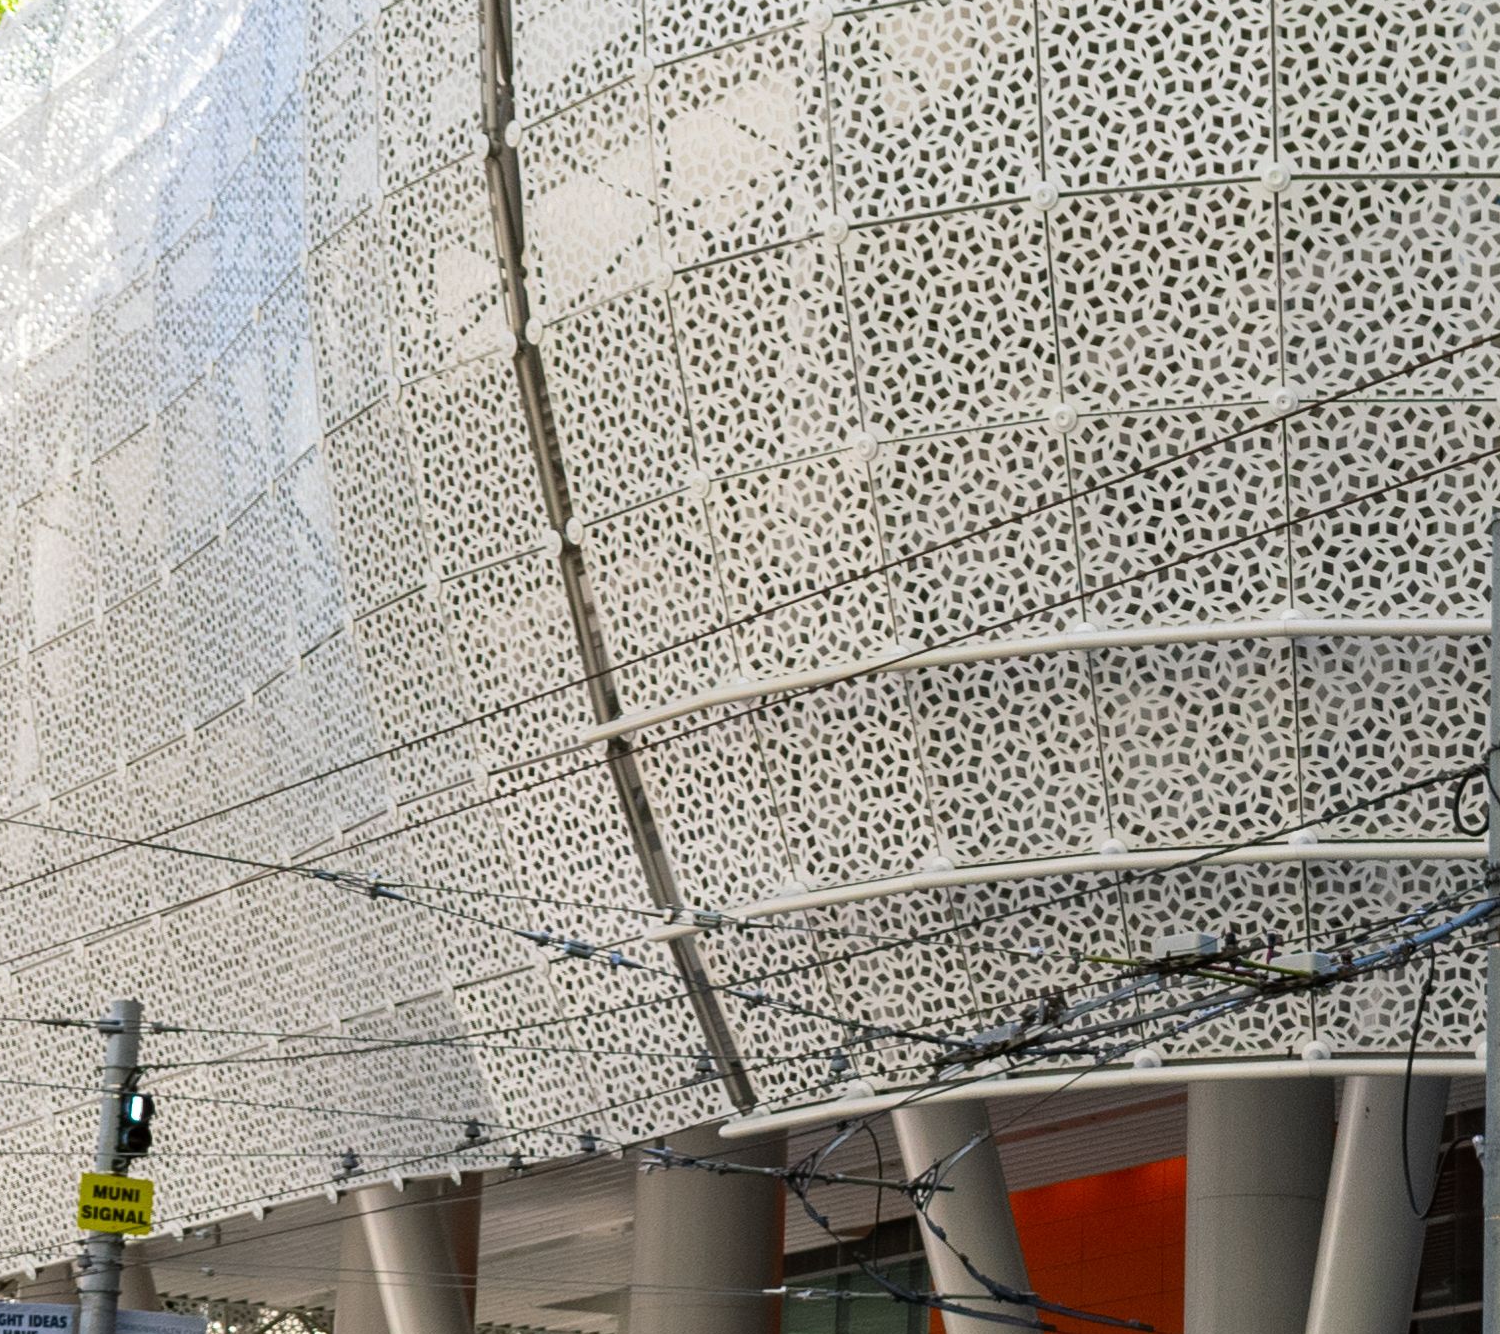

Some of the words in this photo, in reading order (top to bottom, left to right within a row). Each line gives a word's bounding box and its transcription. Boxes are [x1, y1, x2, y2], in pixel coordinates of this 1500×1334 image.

[92, 1185, 140, 1203] MUNI
[81, 1205, 149, 1225] SIGNAL
[29, 1315, 68, 1329] IDEAS
